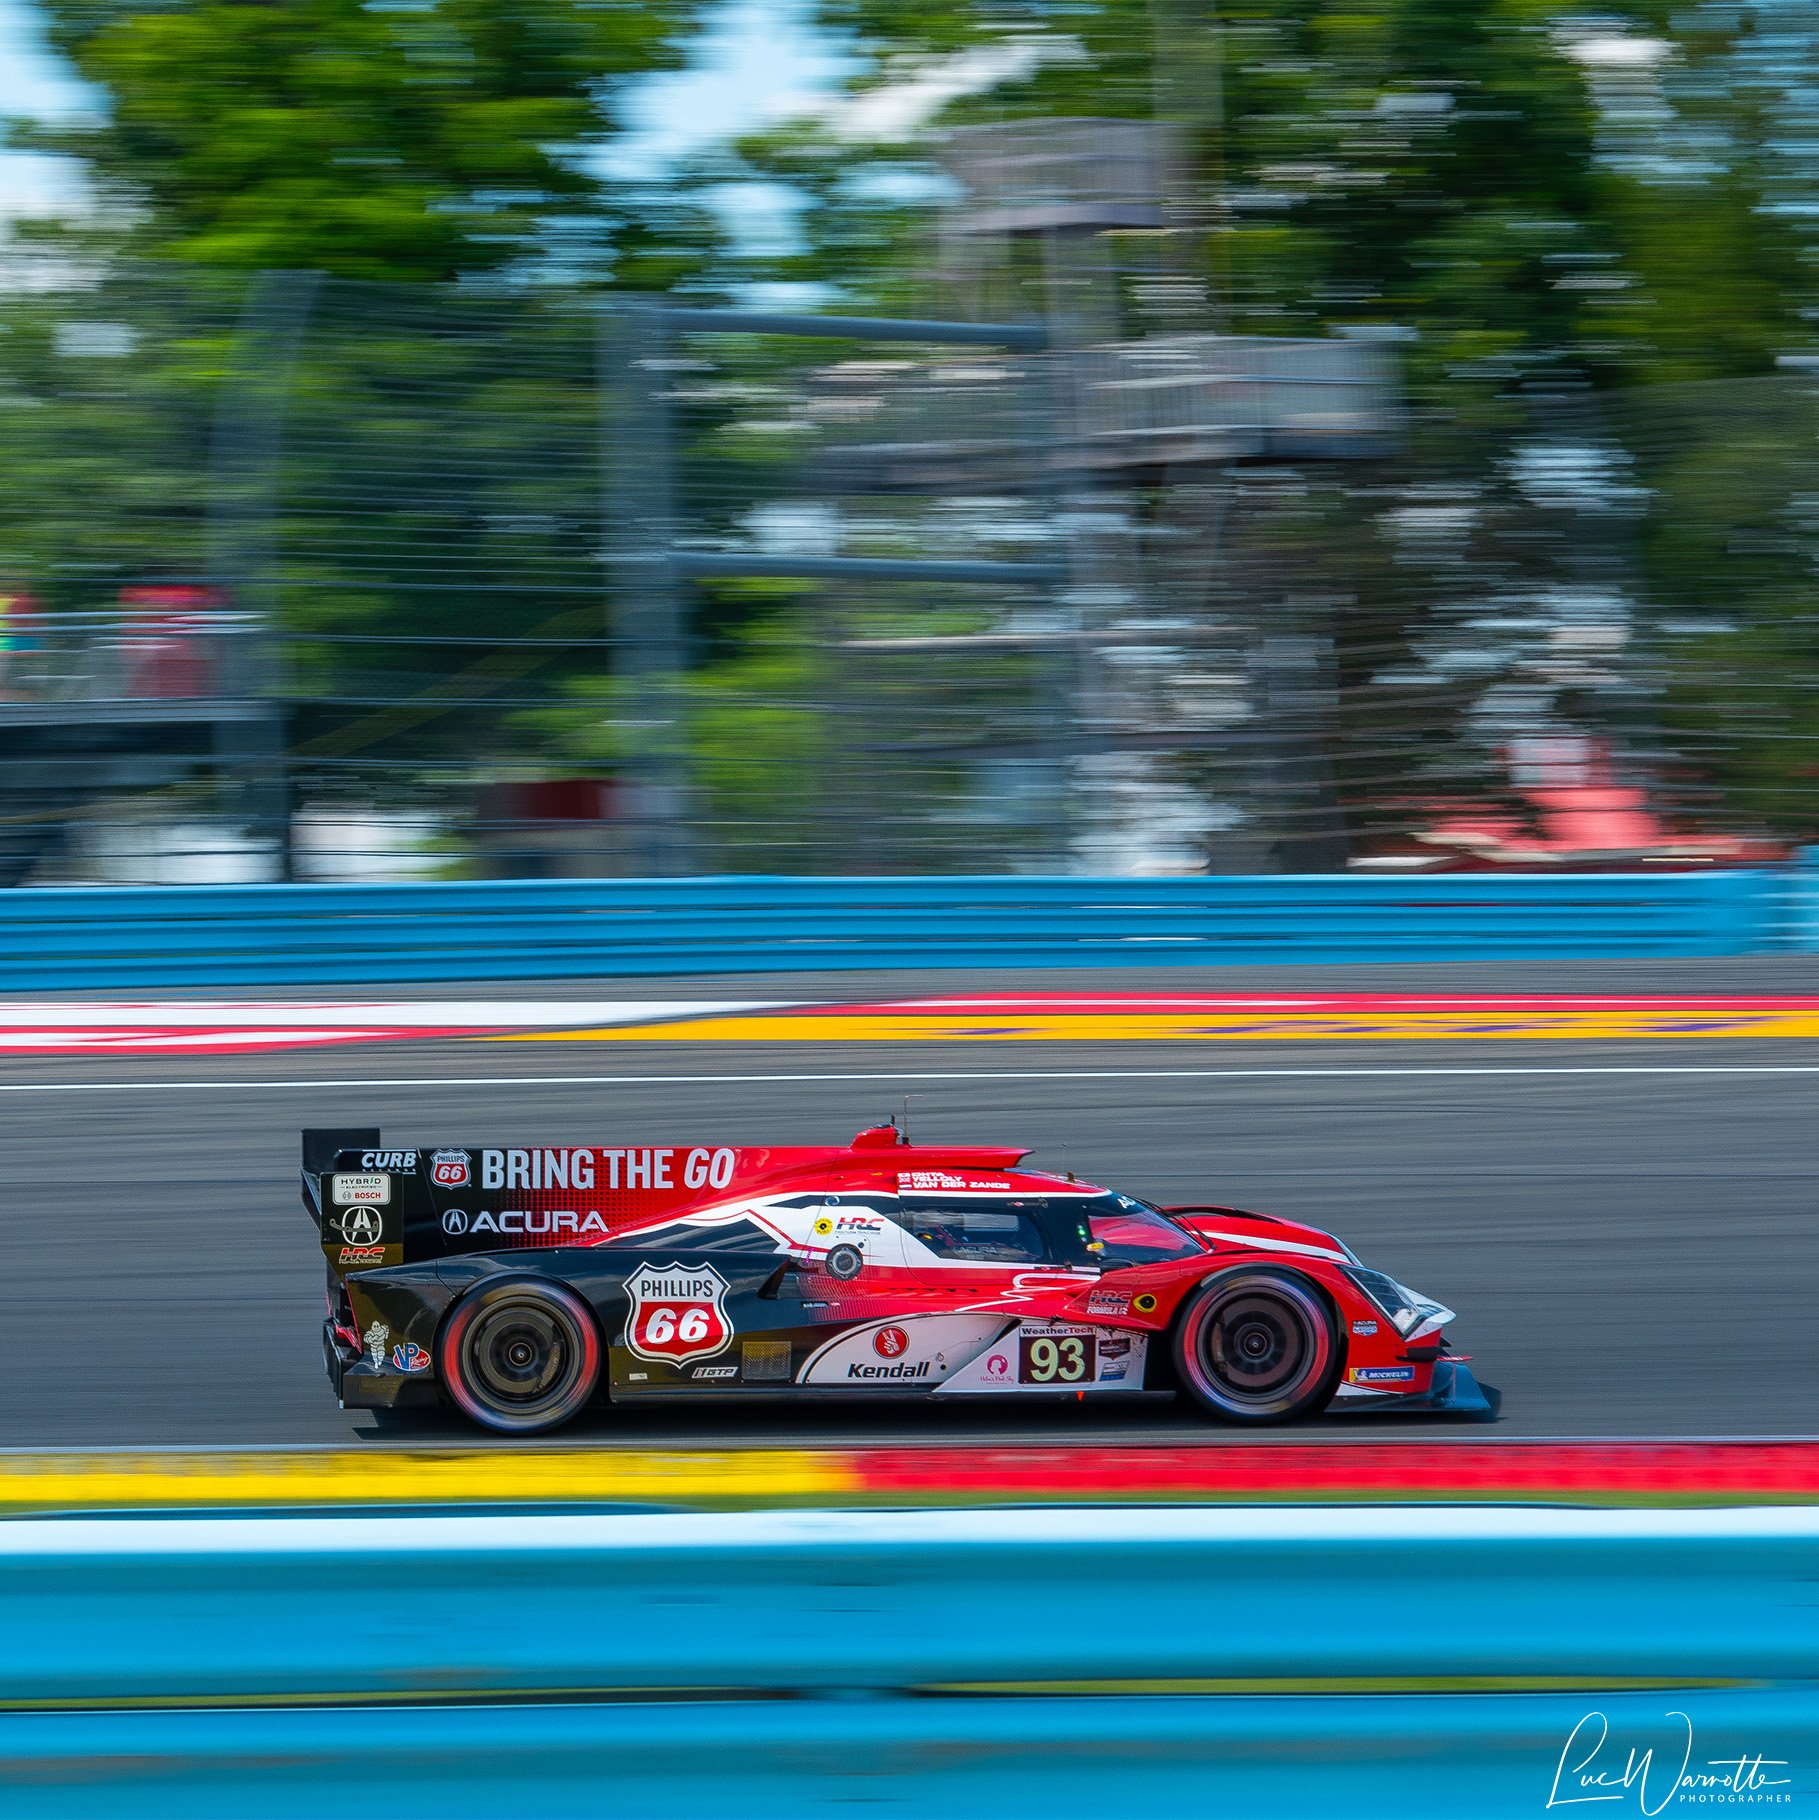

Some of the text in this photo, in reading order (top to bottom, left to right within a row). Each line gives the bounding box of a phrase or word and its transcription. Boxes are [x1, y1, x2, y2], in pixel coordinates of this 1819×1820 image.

[361, 1152, 417, 1168] CURB
[437, 1154, 465, 1163] PHILLIPS
[438, 1165, 463, 1180] 66
[482, 1148, 735, 1190] BRING THE GO
[341, 1177, 382, 1185] HYBRID
[913, 1181, 938, 1189] VAN
[969, 1181, 1011, 1189] ZANDE
[469, 1210, 610, 1233] ACURA
[836, 1217, 885, 1231] HRC
[339, 1246, 386, 1261] HRC
[641, 1279, 714, 1298] PHILLIPS
[645, 1307, 710, 1345] 66
[1021, 1326, 1094, 1335] WeatherTech
[393, 1342, 420, 1370] VP
[1030, 1337, 1086, 1382] 93
[847, 1361, 931, 1378] Kendall
[1368, 1371, 1410, 1379] MICHELIN
